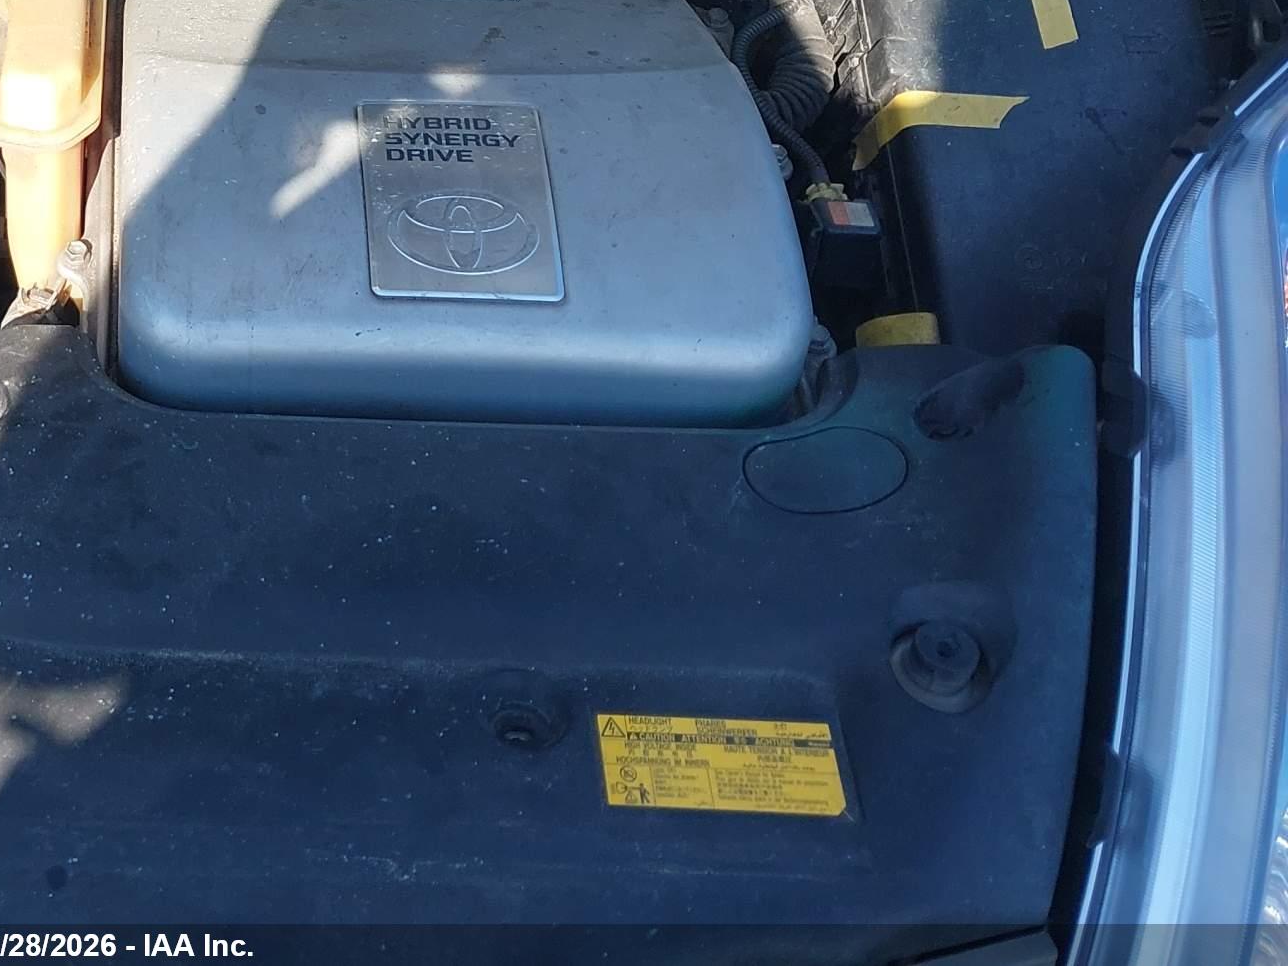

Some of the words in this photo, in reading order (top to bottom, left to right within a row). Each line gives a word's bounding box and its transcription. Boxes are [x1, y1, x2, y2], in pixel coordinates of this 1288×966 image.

[383, 116, 492, 130] HYBRID
[385, 132, 520, 147] SYNERGY
[386, 148, 474, 162] DRIVE
[628, 716, 672, 726] HEADLIGHT
[640, 733, 675, 742] CAUTION
[681, 734, 727, 744] ATTENTION
[757, 737, 794, 747] ACHTUNG
